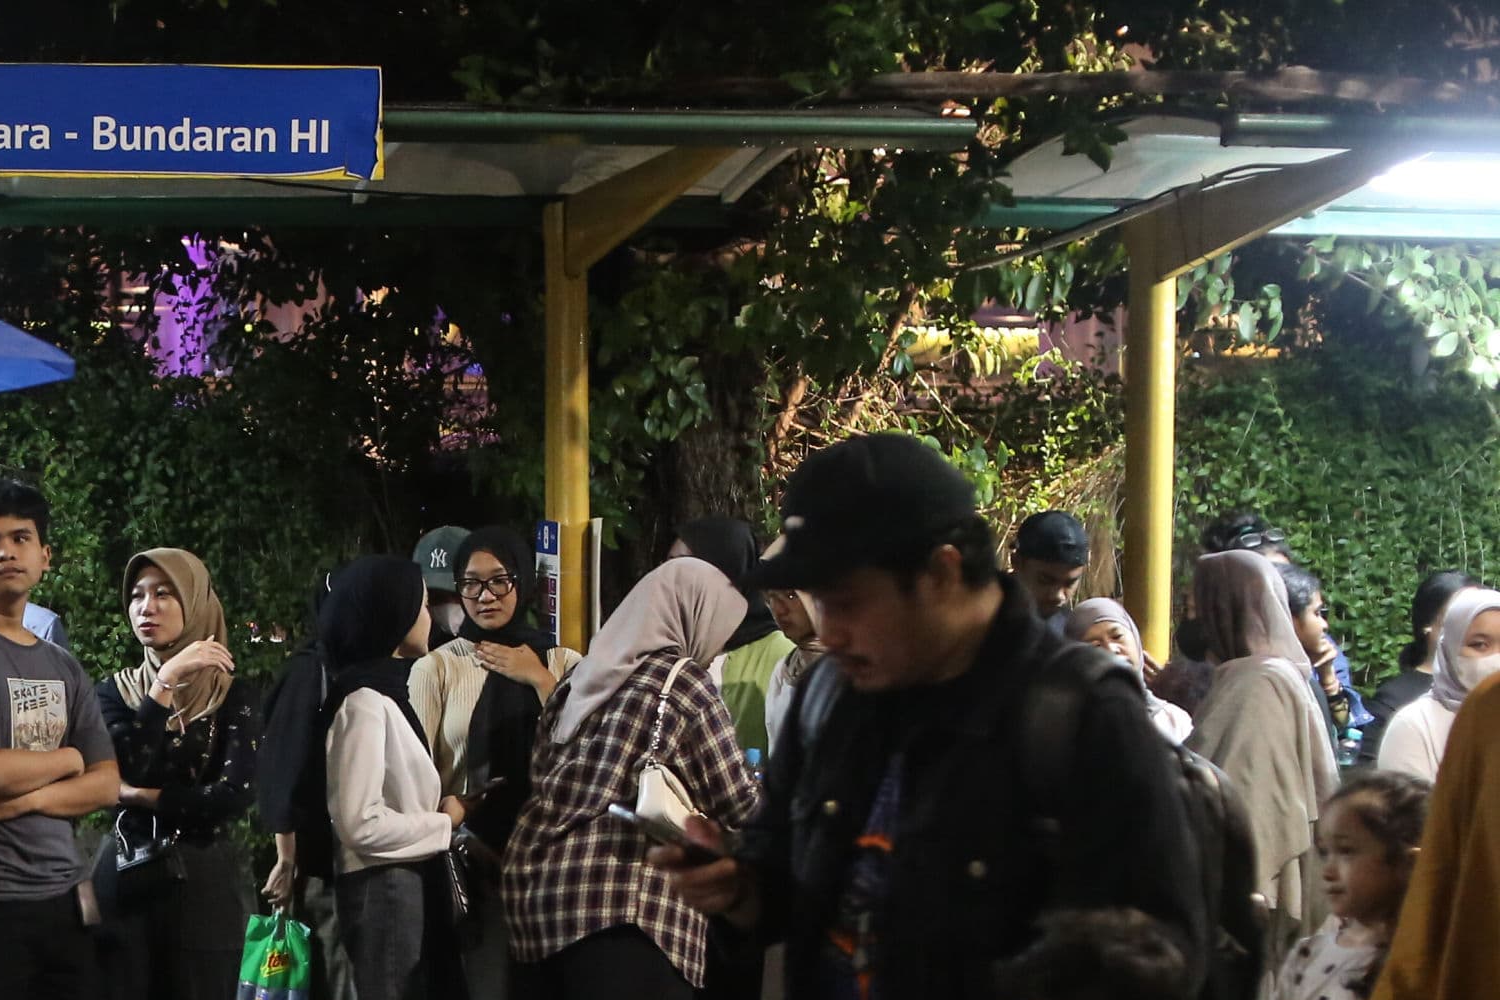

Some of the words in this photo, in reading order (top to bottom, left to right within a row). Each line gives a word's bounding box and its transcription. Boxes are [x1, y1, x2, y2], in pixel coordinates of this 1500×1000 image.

[64, 131, 79, 141] -
[92, 115, 277, 153] Bundaran
[290, 118, 330, 153] HI
[430, 548, 447, 568] NY
[13, 684, 49, 701] SKATE
[17, 696, 48, 714] FREE
